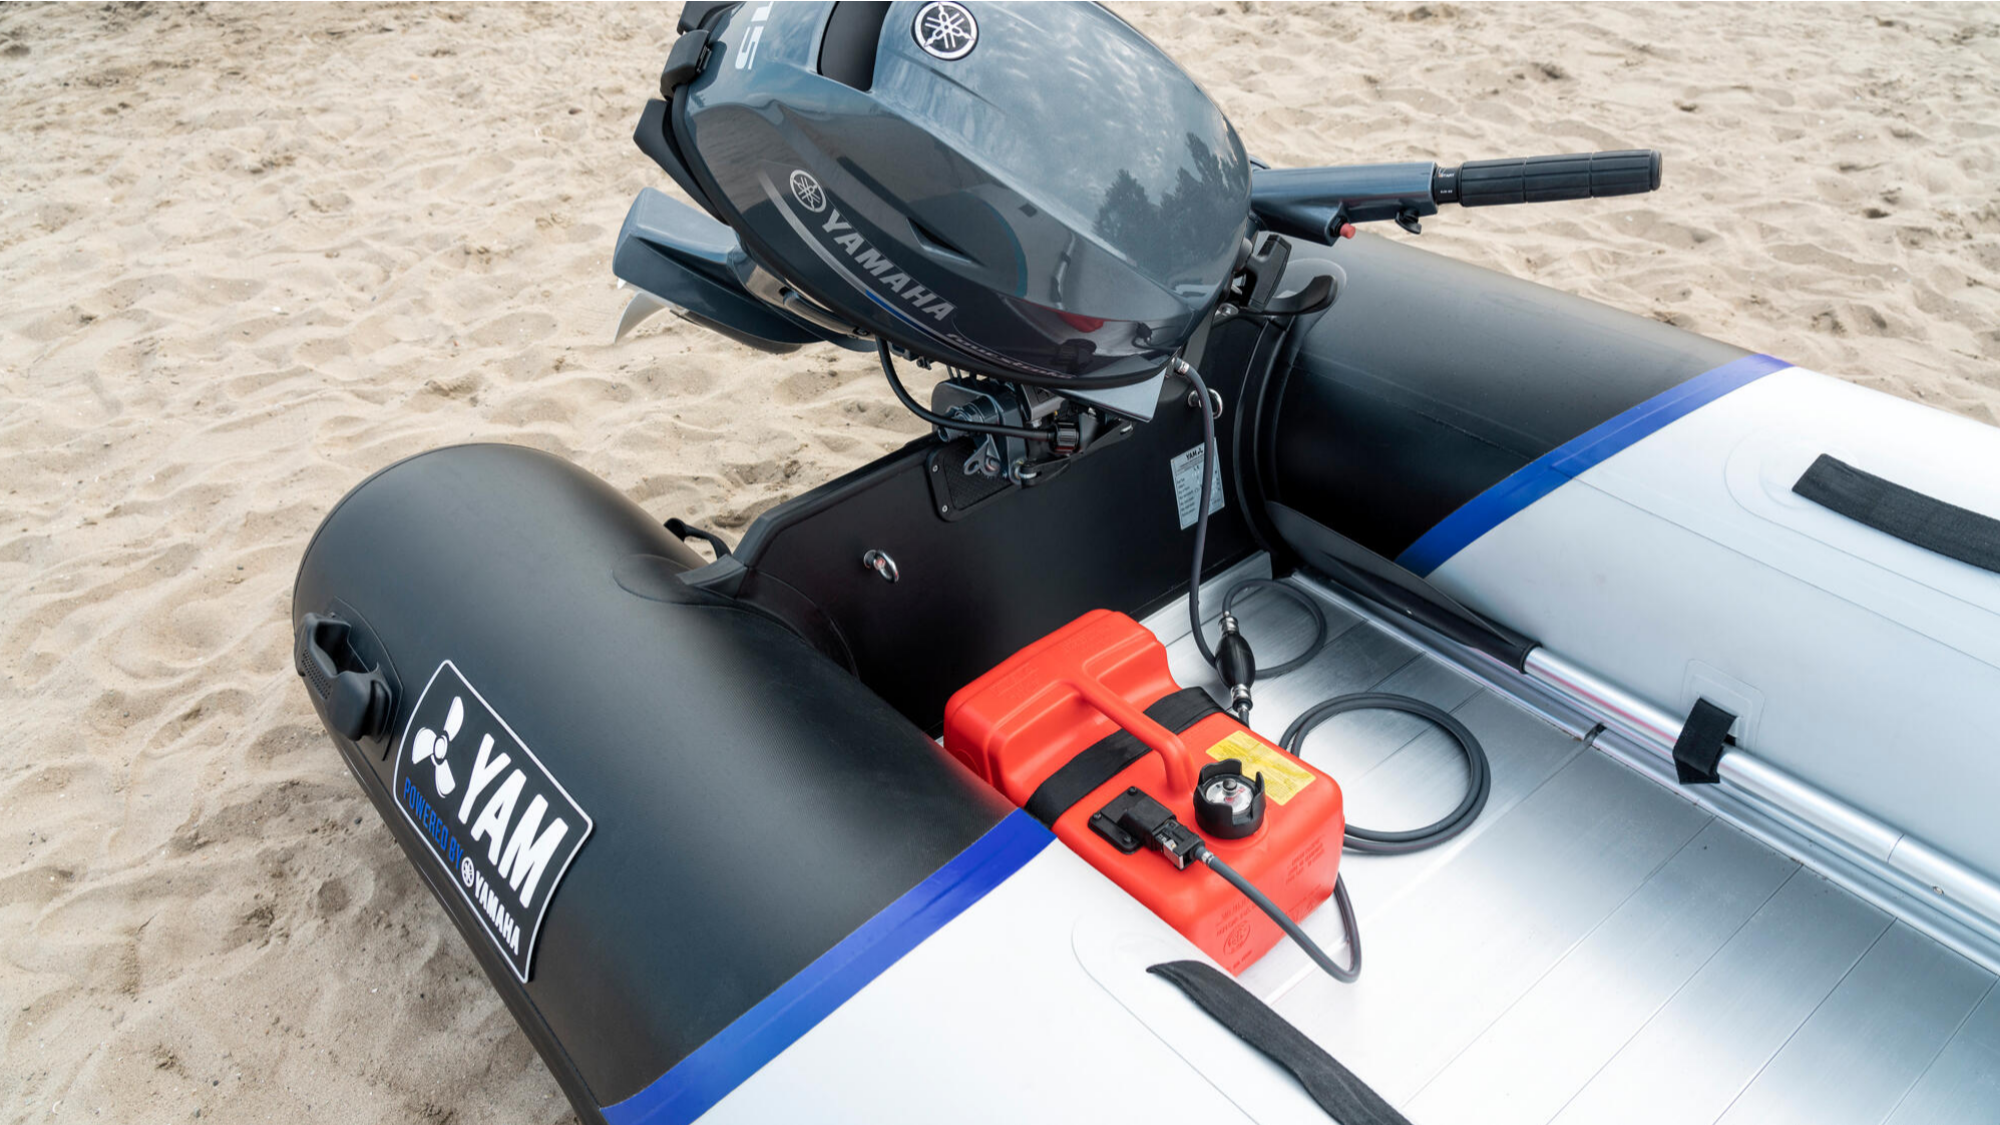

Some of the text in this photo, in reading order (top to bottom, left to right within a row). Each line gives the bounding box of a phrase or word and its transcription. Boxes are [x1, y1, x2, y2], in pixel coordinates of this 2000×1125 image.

[821, 209, 957, 322] YAMAHA
[1186, 450, 1197, 460] YAM
[403, 776, 464, 871] POWERED BY
[458, 733, 569, 909] YAM
[474, 869, 521, 956] YAMAHA
